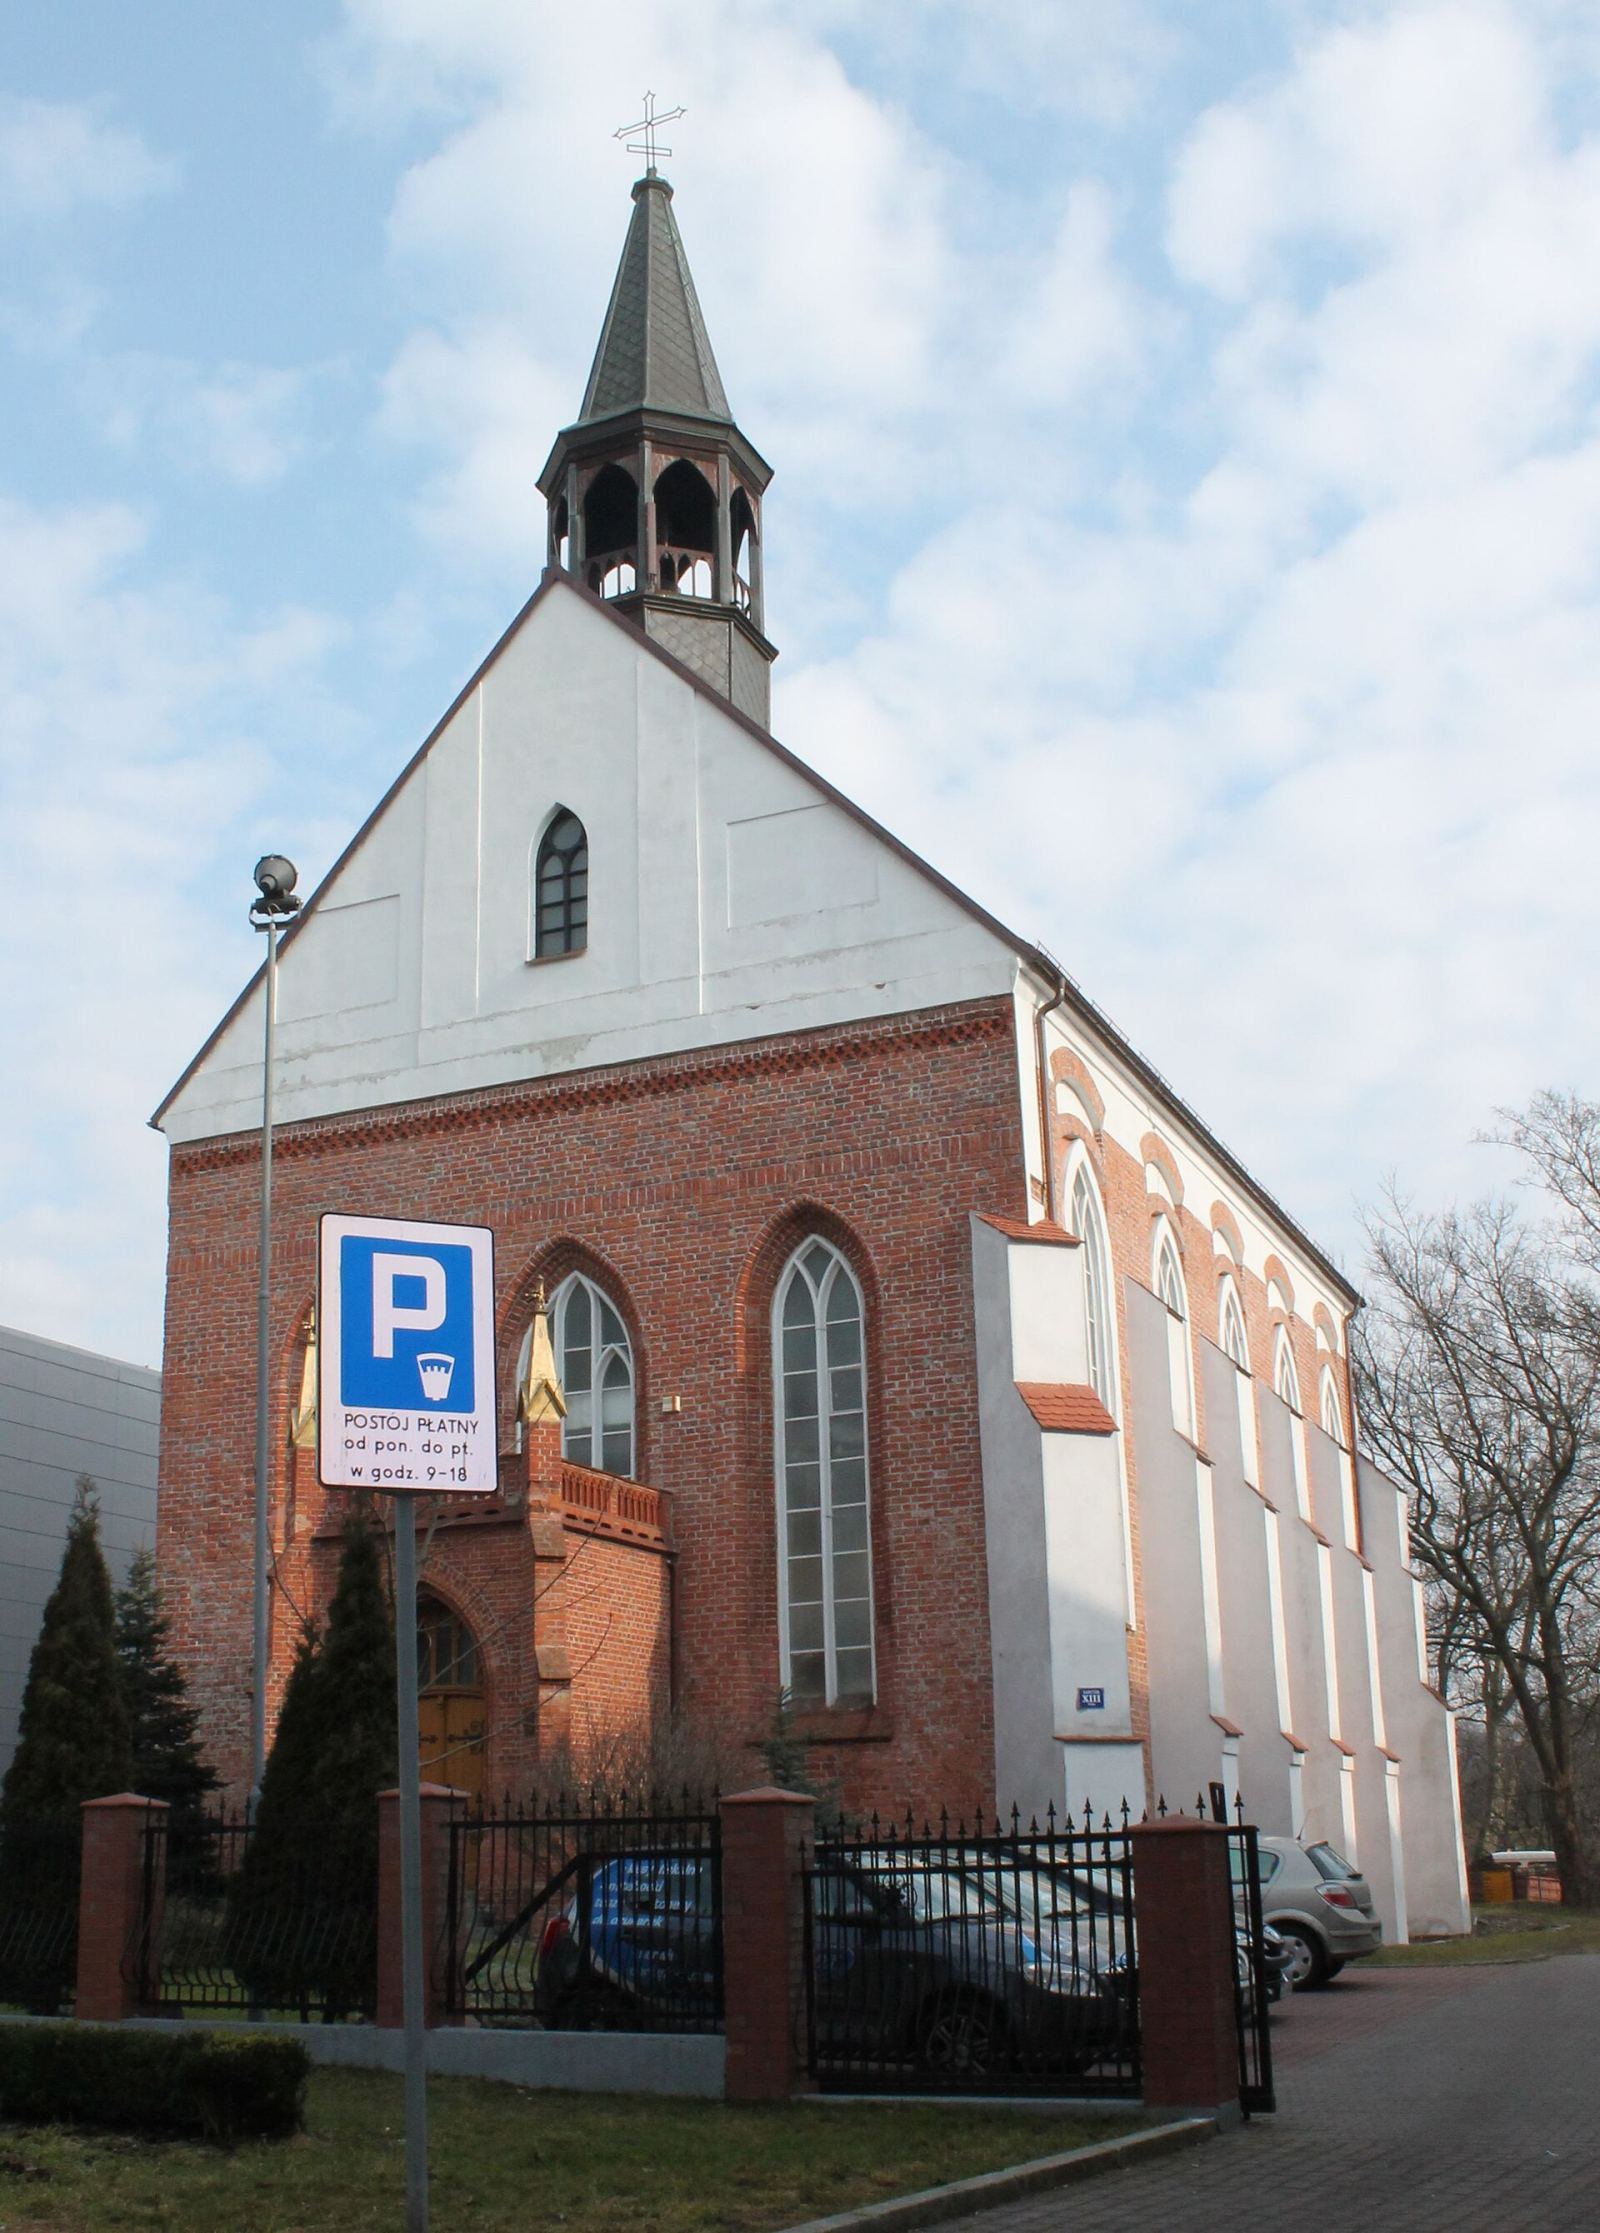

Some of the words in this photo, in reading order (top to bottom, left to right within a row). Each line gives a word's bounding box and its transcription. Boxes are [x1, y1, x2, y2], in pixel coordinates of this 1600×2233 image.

[372, 1252, 447, 1359] P
[344, 1412, 409, 1431] POSTÓJ
[417, 1418, 479, 1434] PŁATNY
[344, 1435, 366, 1449] od
[375, 1441, 413, 1455] pon.
[421, 1439, 443, 1454] do
[451, 1441, 474, 1459] pt.
[351, 1466, 363, 1477] w
[371, 1465, 419, 1482] godz.
[427, 1466, 468, 1482] 9-18
[1082, 1694, 1101, 1703] XIII
